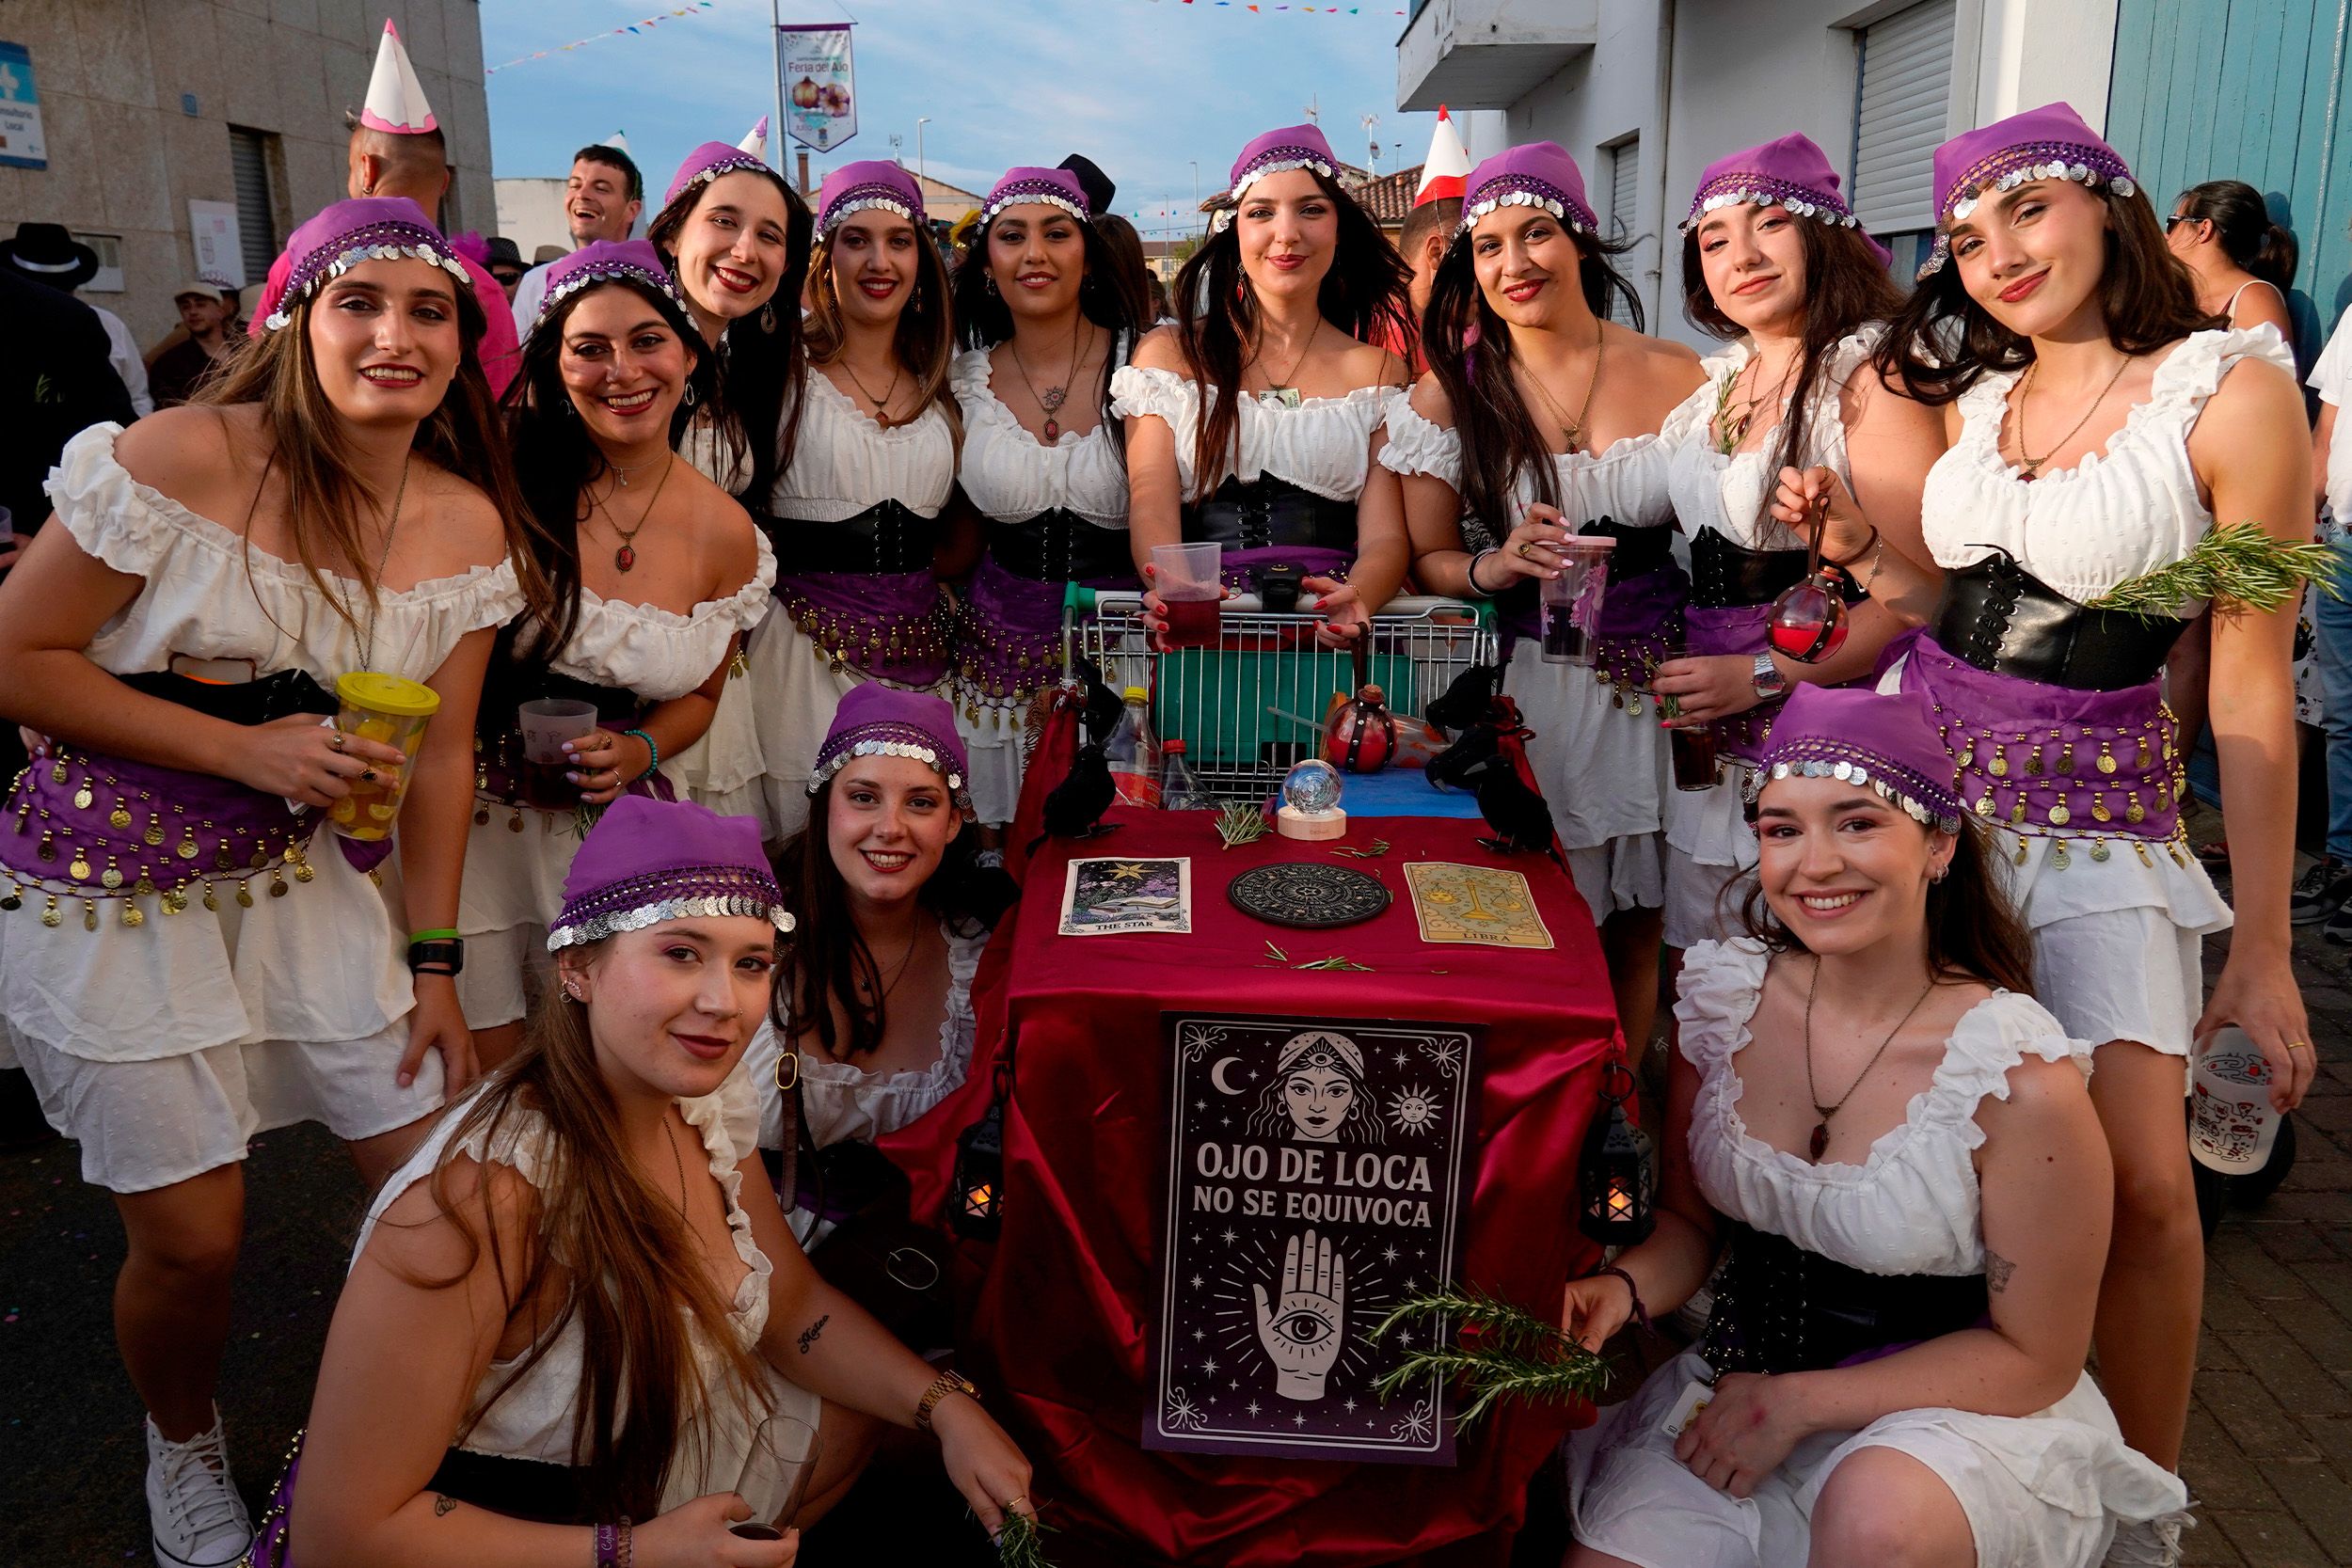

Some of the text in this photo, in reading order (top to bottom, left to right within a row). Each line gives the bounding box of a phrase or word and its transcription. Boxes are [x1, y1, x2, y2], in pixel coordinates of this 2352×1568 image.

[788, 62, 813, 72] Feria
[816, 62, 829, 72] del
[1463, 933, 1512, 942] LIBRA
[1197, 1142, 1433, 1193] OJO DE LOCA
[1193, 1185, 1432, 1227] NO SE EQUIVOCA
